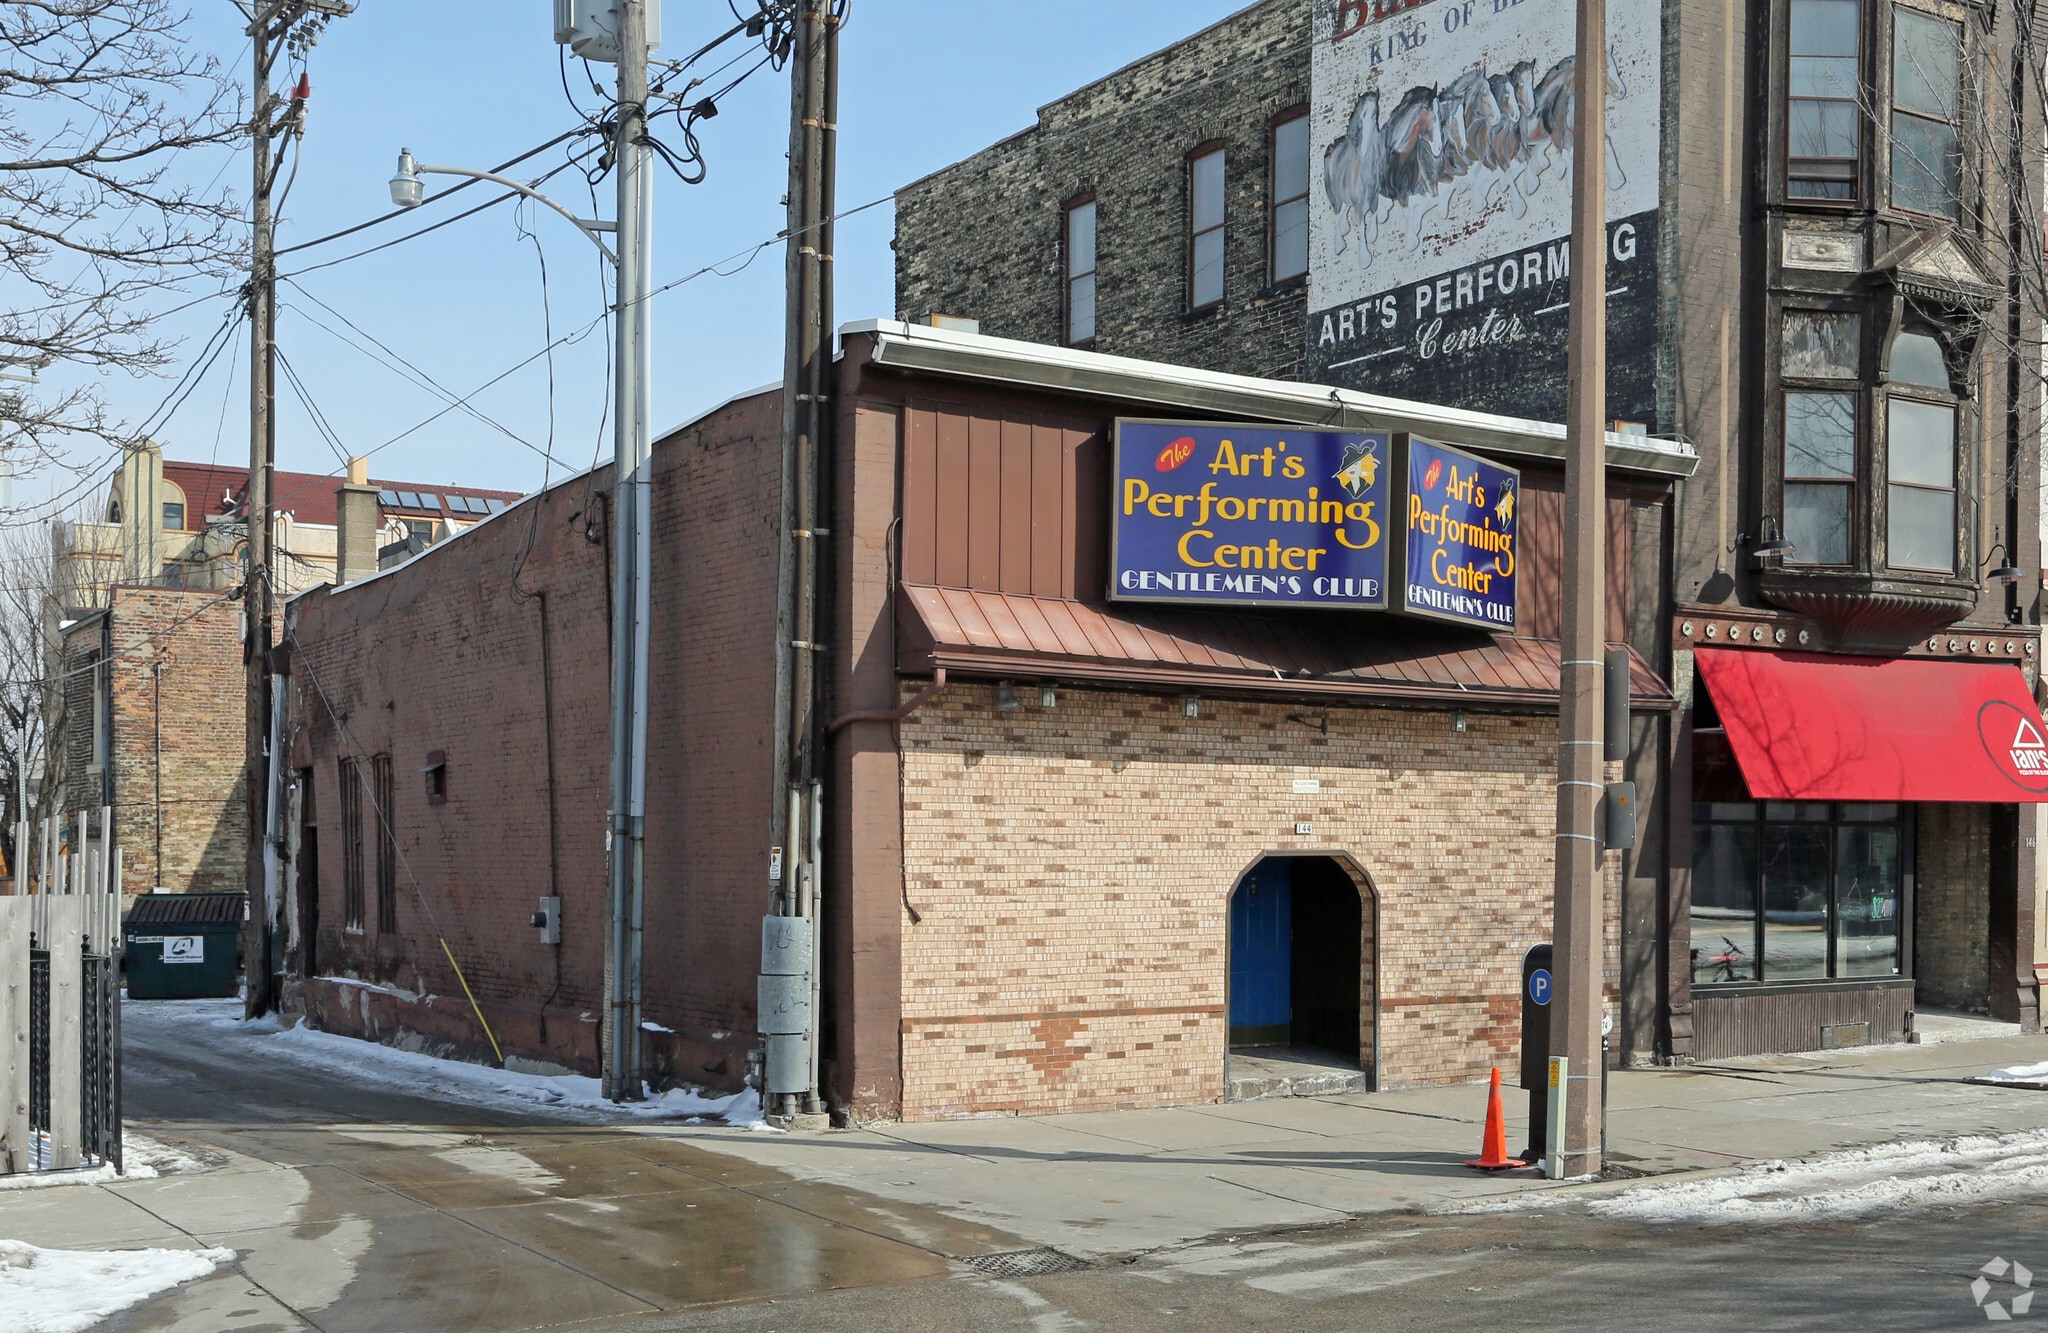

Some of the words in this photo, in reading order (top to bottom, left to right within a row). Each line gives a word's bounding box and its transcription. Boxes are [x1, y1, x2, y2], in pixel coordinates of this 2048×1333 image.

[1369, 21, 1427, 67] KING
[1444, 0, 1476, 33] OF
[1319, 295, 1397, 348] ART'S
[1415, 223, 1636, 320] PERFORMG
[1415, 308, 1522, 359] Center
[1162, 445, 1190, 469] The
[1208, 439, 1306, 479] Art's
[1426, 463, 1440, 487] The
[1446, 465, 1486, 508] Art's
[1123, 478, 1380, 549] Performing
[1177, 530, 1327, 571] Center
[1409, 493, 1515, 577] Performing
[1121, 569, 1301, 595] GENTLEMEN'S
[1313, 576, 1378, 598] CLUB
[1431, 548, 1492, 594] Center
[1408, 583, 1483, 617] GENTLEMEN'S
[1486, 602, 1513, 623] CLUB
[1298, 824, 1311, 833] 144
[1536, 977, 1547, 997] P
